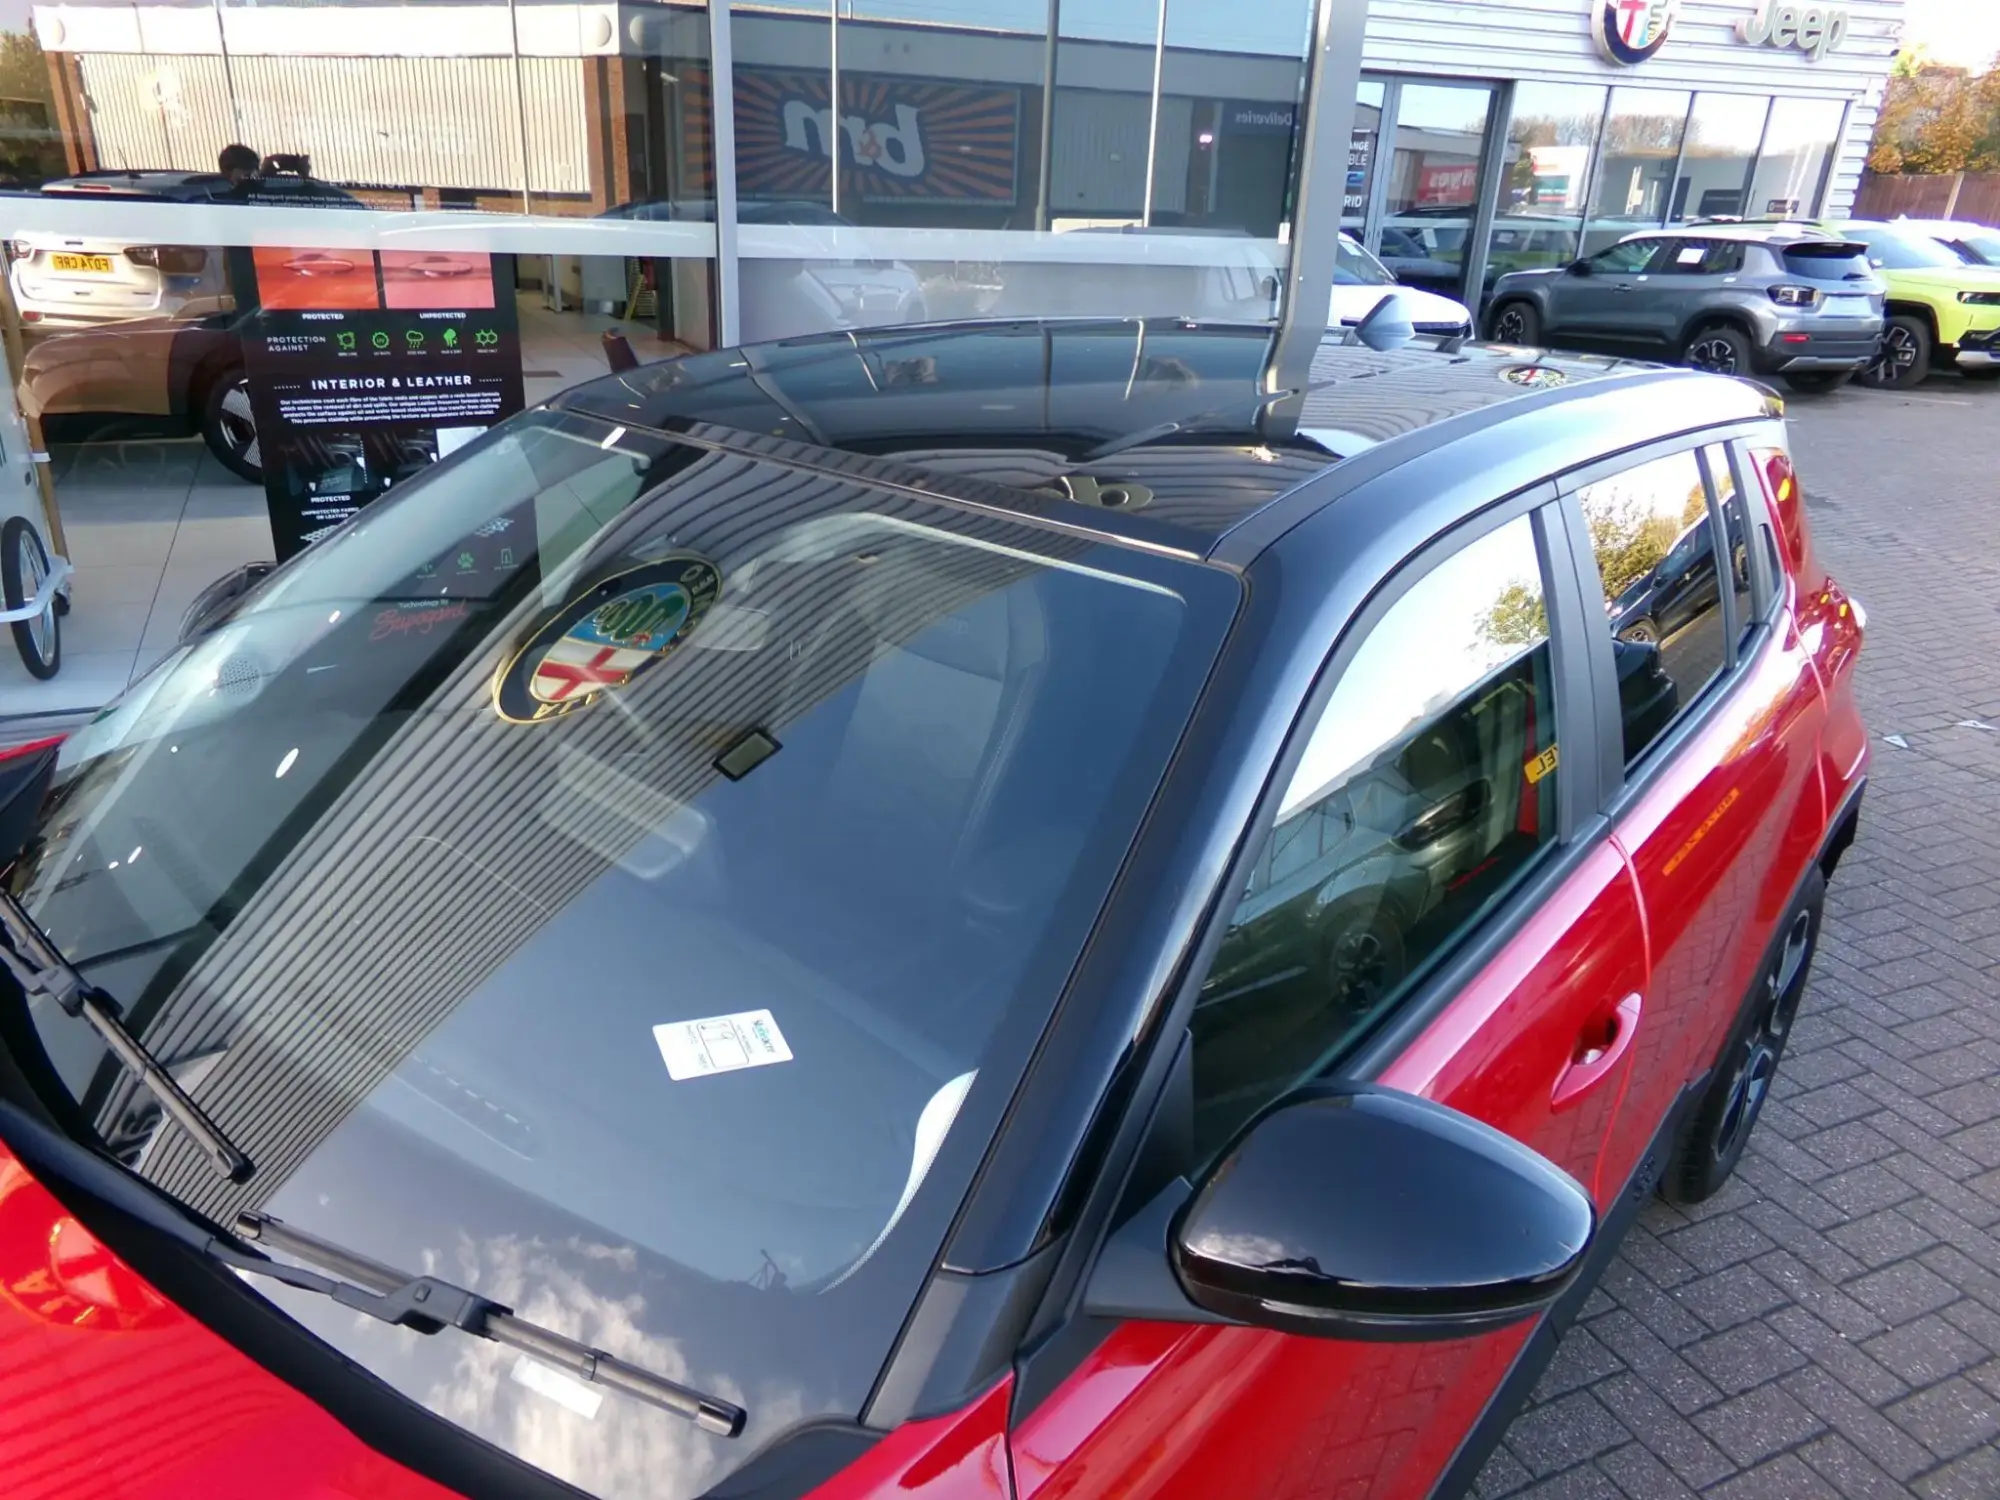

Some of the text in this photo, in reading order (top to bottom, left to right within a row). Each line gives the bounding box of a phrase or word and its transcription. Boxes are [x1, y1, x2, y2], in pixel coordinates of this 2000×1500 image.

[1738, 0, 1848, 61] Jeep
[266, 336, 326, 344] PROTECTION
[268, 344, 309, 352] AGAINST
[311, 375, 472, 390] INTERIOR & LEATHER
[310, 495, 351, 503] PROTECTED
[399, 600, 439, 609] Technology
